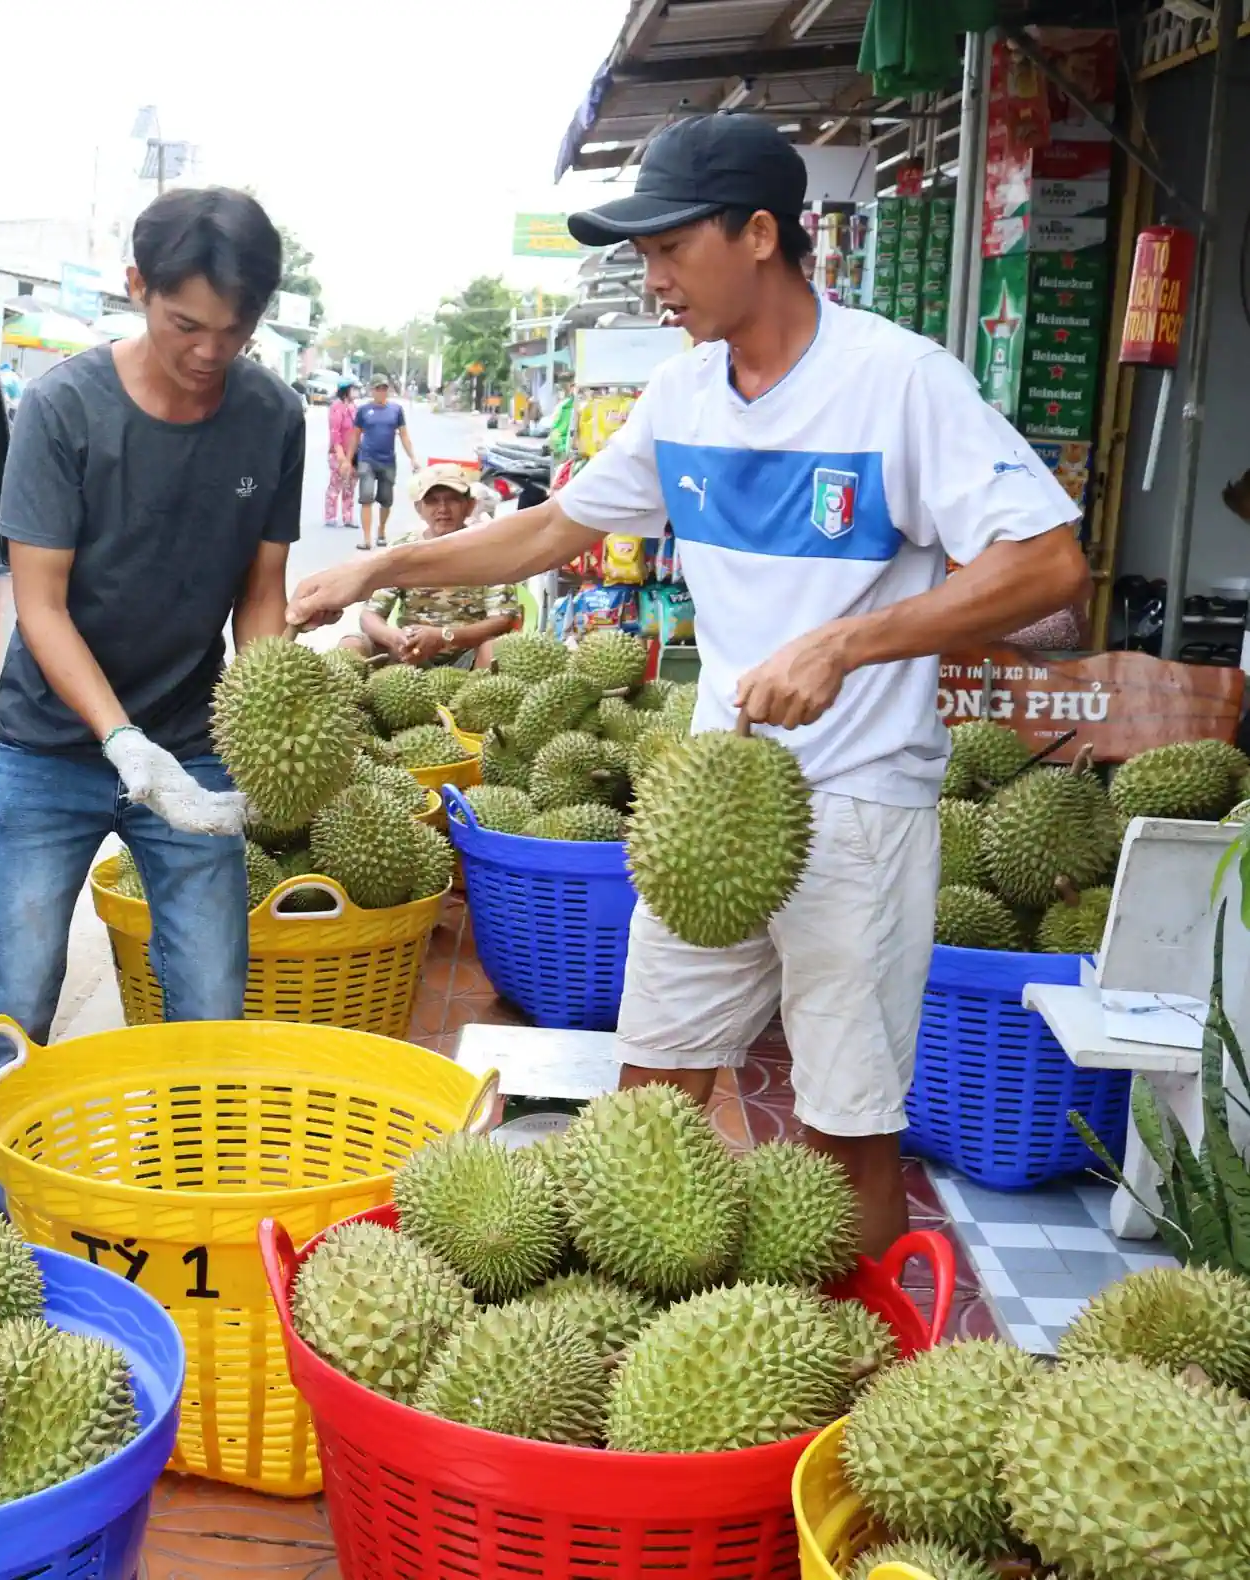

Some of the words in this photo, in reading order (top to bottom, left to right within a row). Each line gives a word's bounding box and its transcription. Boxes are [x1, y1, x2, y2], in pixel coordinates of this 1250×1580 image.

[1038, 275, 1094, 290] Heineken
[1035, 312, 1091, 327] Heineken
[1031, 349, 1087, 364] Heineken
[1028, 386, 1083, 401] Heineken
[1025, 422, 1079, 437] Heineken
[938, 664, 961, 679] CTY
[967, 665, 1001, 680] TNH
[182, 1244, 220, 1299] 1
